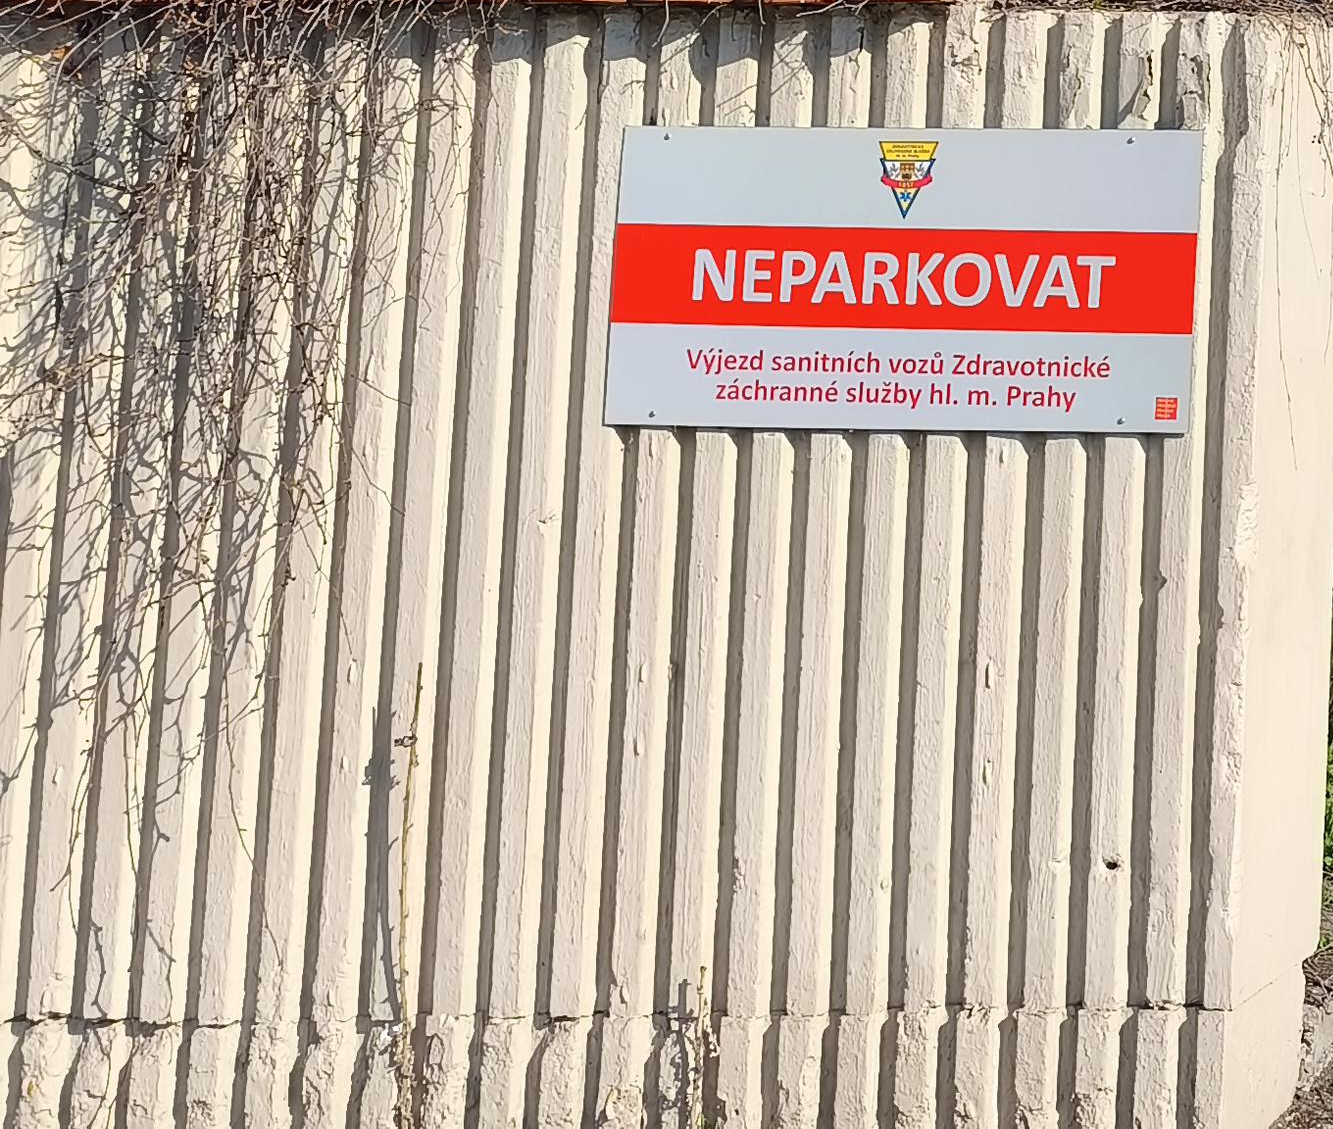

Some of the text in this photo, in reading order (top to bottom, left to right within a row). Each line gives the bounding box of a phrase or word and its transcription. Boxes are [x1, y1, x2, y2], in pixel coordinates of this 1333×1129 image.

[691, 248, 1117, 308] NEPARKOVAT
[686, 348, 1112, 378] Výjezd sanitních vozů Zdravotnické
[715, 378, 1077, 413] záchranné služby hl. m. Prahy
